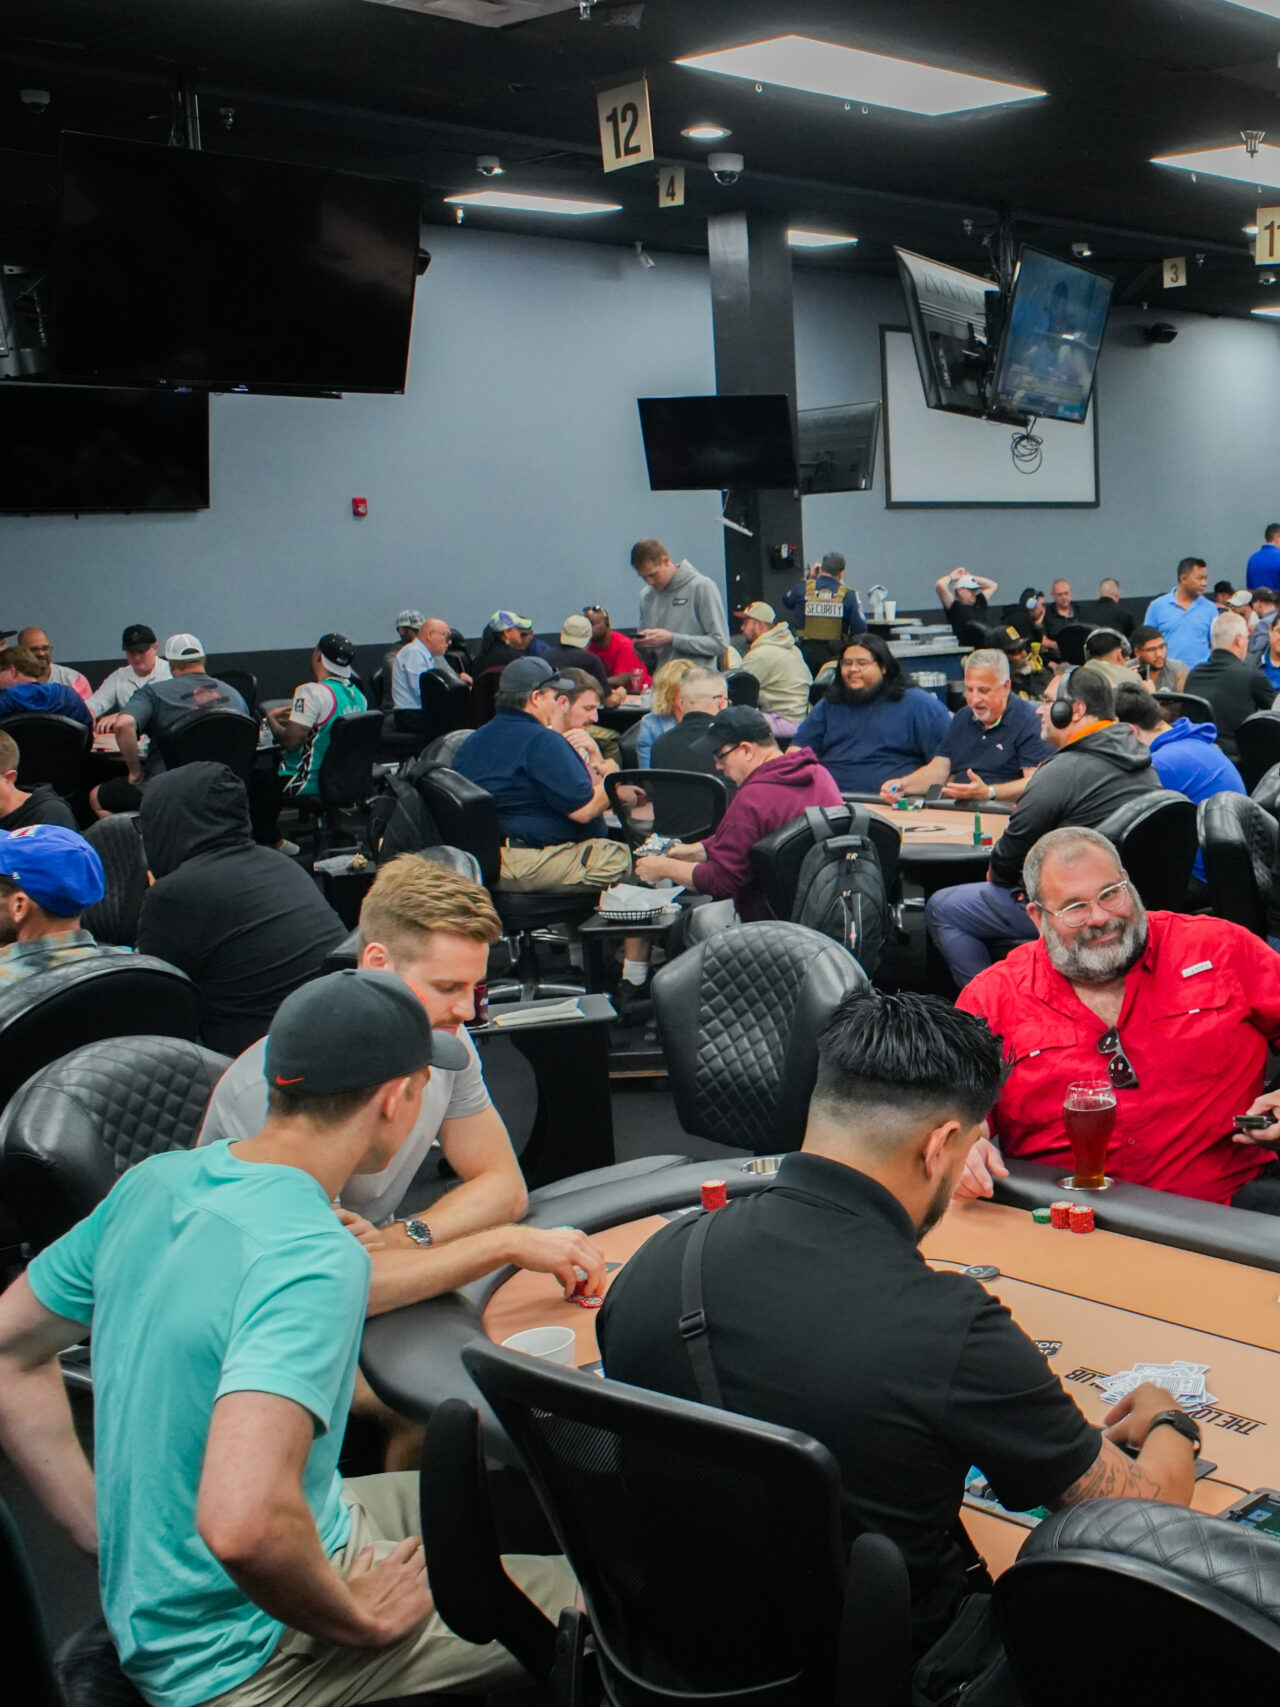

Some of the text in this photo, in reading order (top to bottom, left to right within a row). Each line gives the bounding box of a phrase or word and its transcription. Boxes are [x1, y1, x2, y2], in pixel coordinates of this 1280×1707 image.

[605, 102, 642, 160] 12
[665, 174, 676, 202] 4
[1169, 263, 1179, 284] 3
[806, 603, 844, 615] SECURITY
[1220, 1416, 1260, 1436] THE
